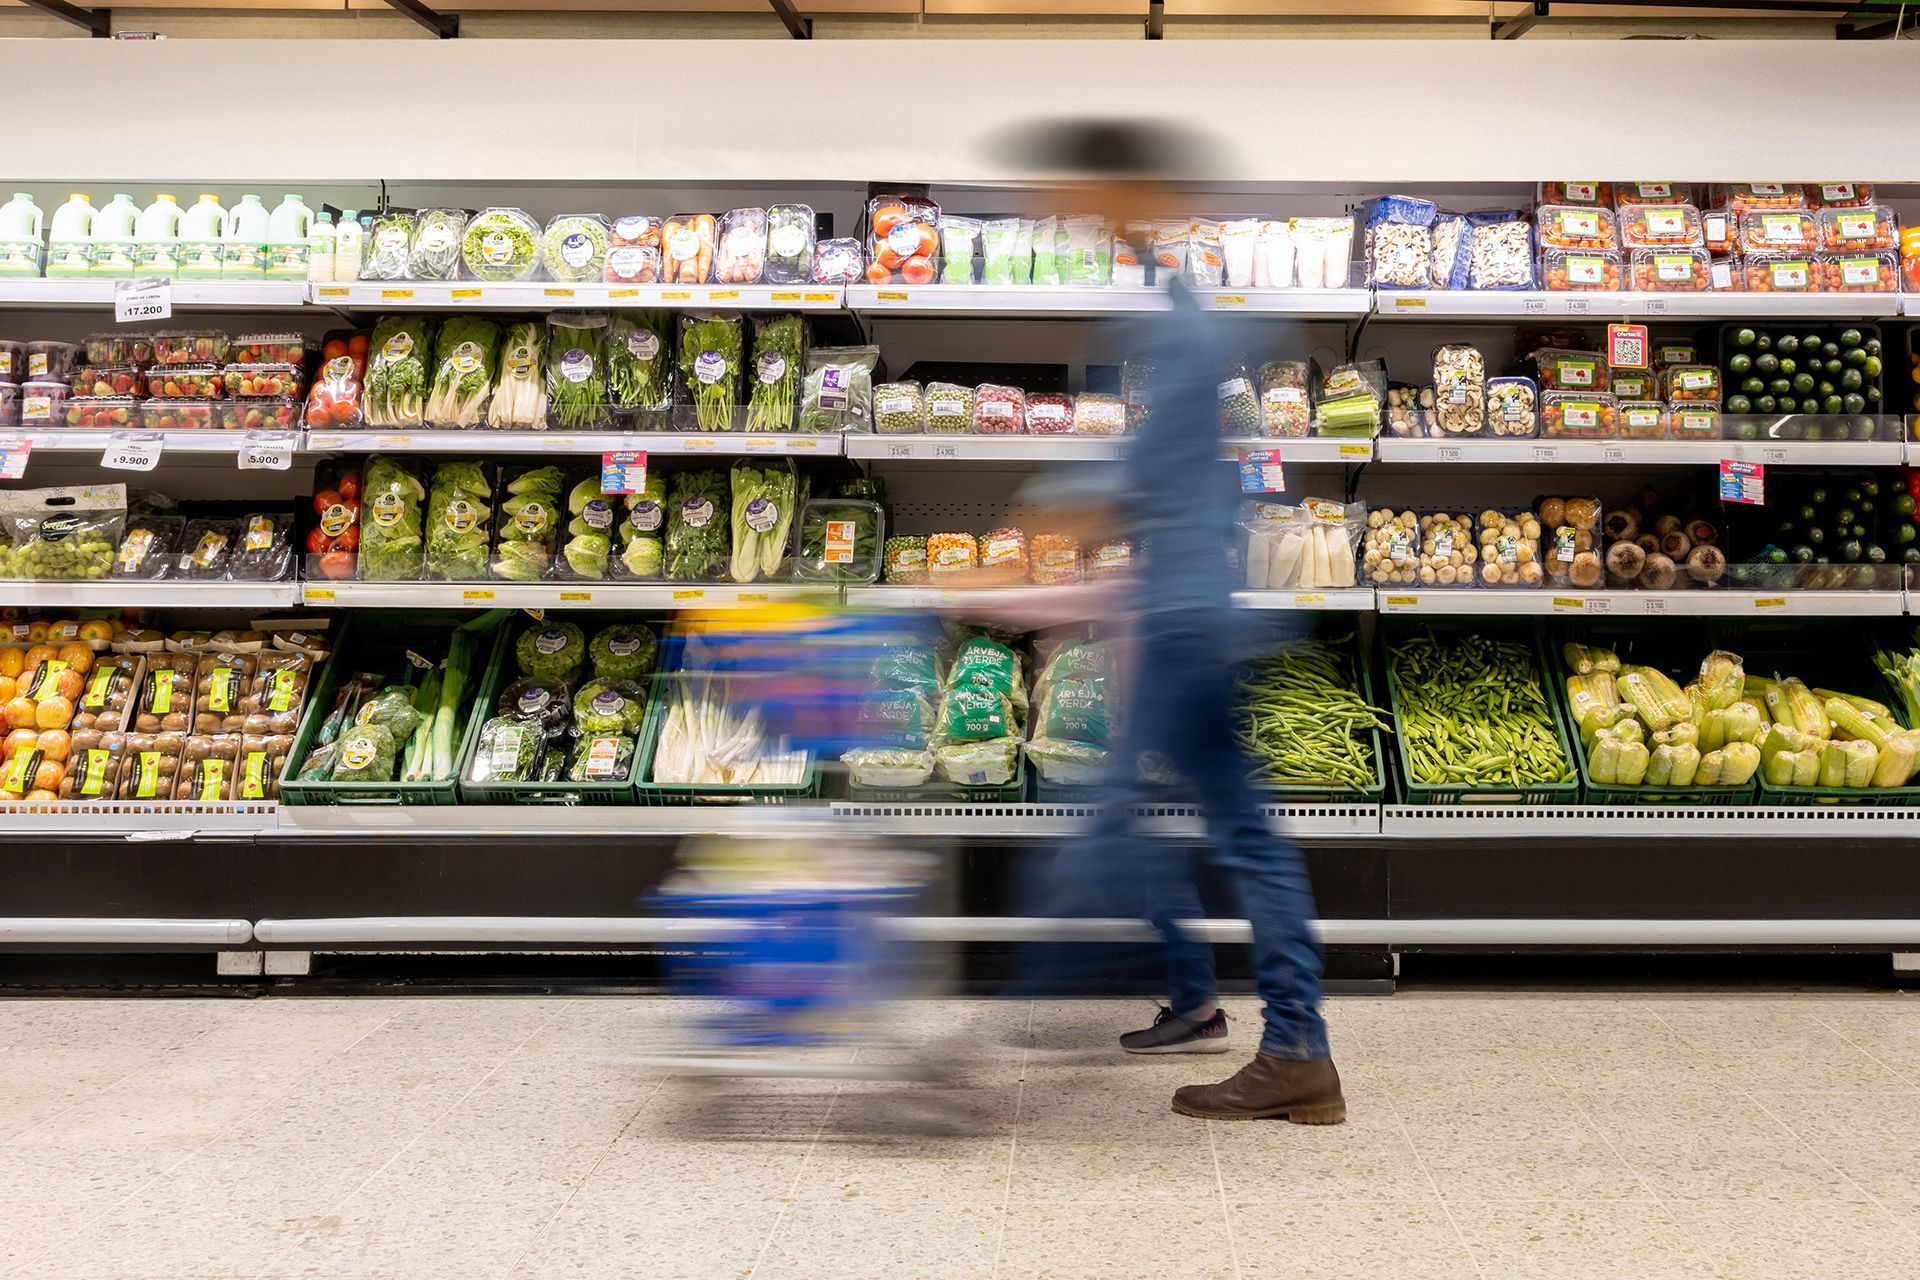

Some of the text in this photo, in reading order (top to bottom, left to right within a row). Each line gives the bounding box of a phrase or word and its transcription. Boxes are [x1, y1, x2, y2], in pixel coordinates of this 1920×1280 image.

[120, 456, 149, 465] 9.900
[966, 646, 1008, 660] ARVEJA
[969, 655, 1002, 666] VERDE
[966, 724, 981, 732] 700
